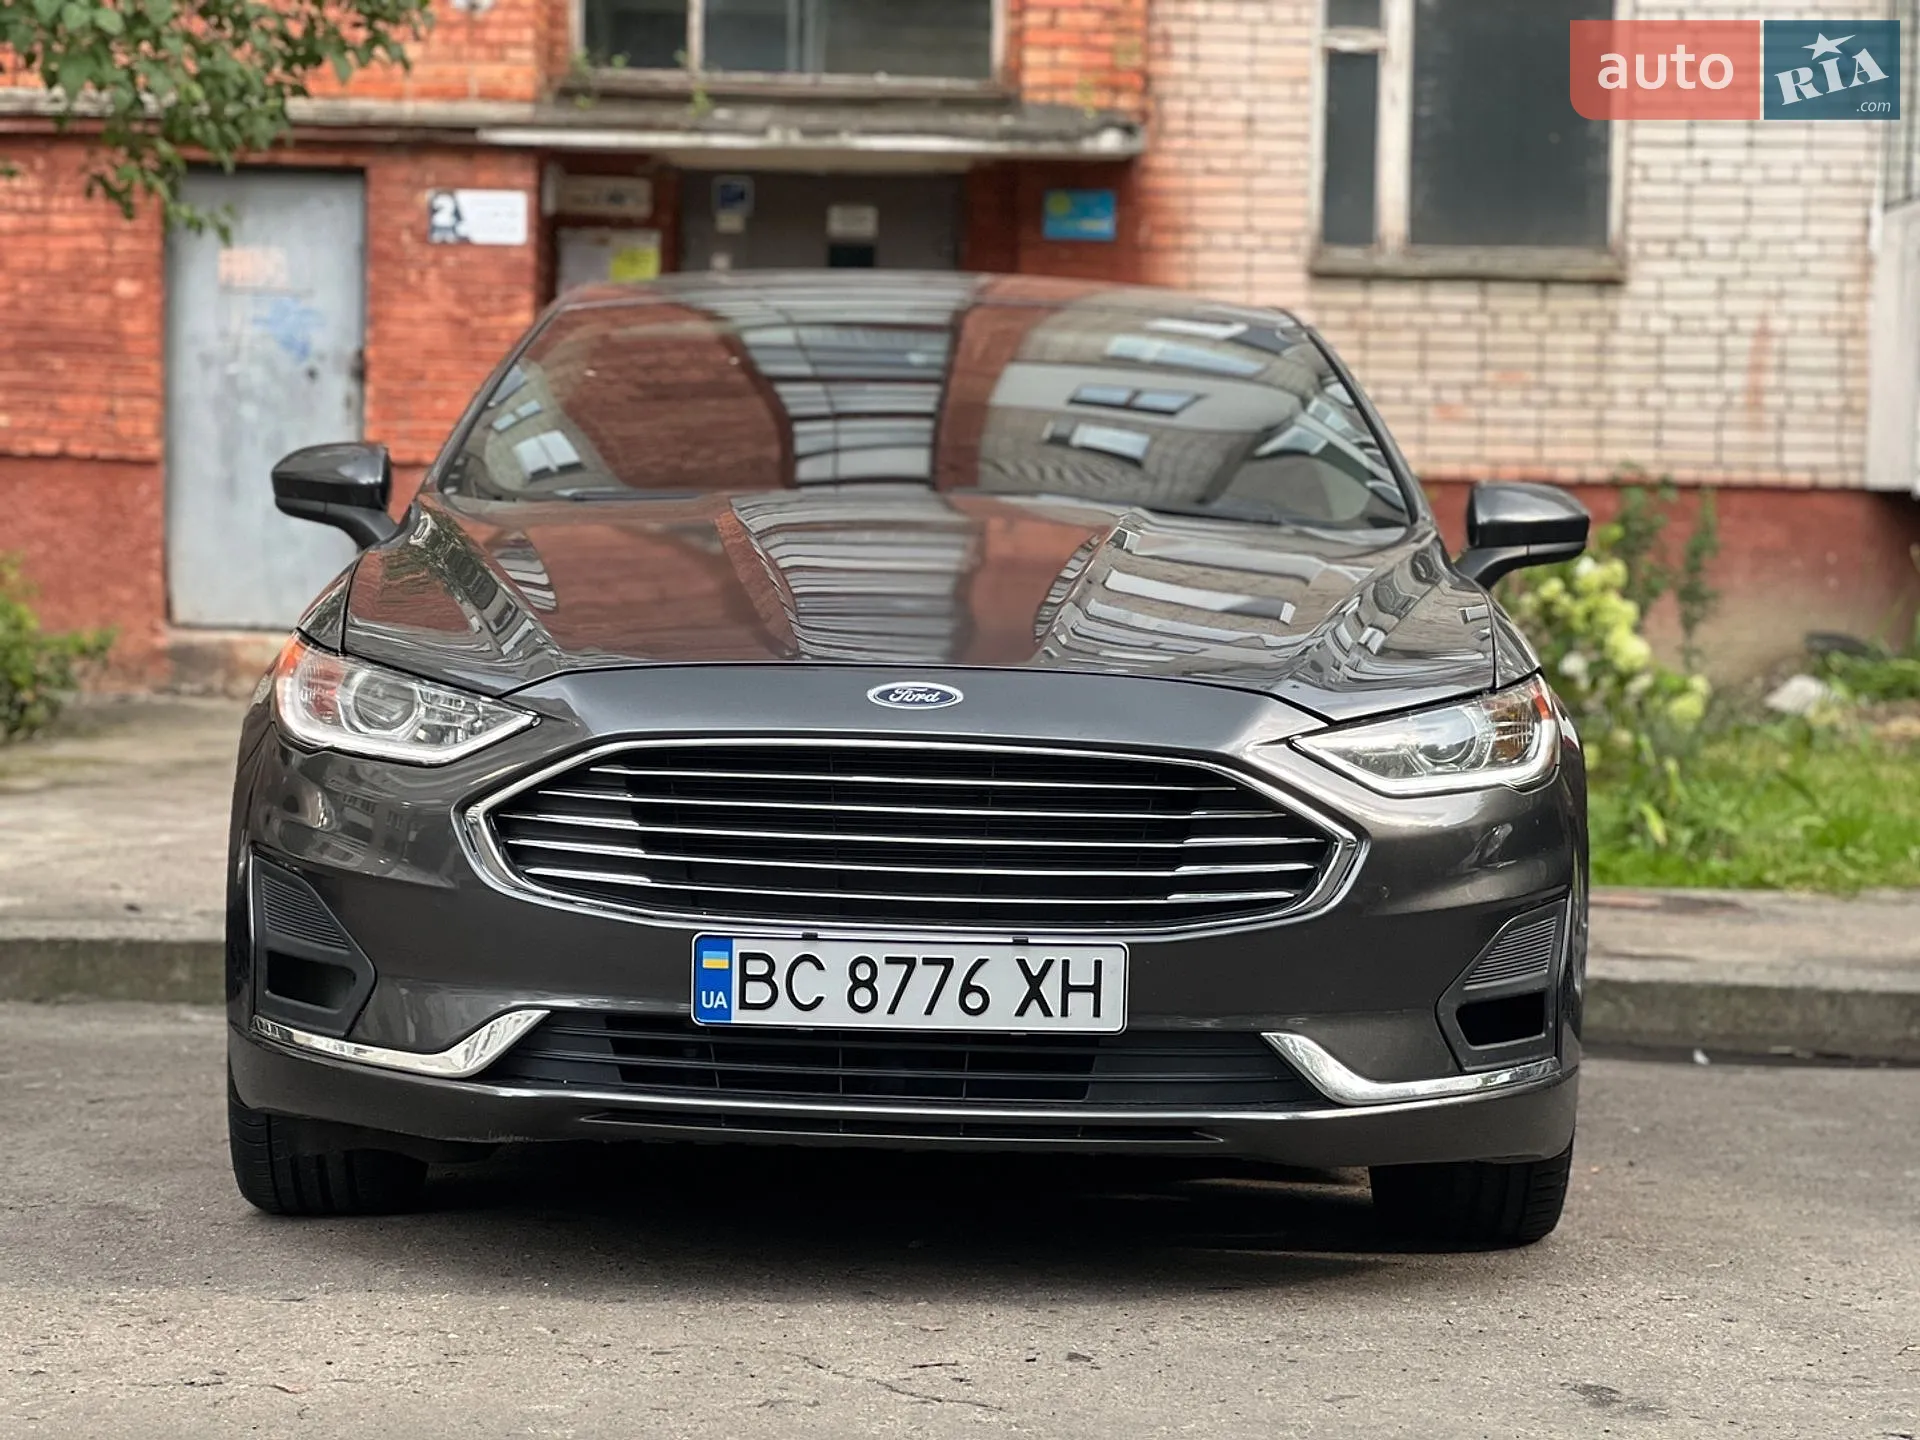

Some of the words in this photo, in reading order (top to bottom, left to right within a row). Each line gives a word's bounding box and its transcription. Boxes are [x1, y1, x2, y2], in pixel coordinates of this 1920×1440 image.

[888, 687, 941, 702] Ford
[738, 951, 826, 1012] BC
[846, 956, 991, 1017] 8776
[1014, 957, 1103, 1018] XH
[701, 990, 728, 1010] UA
